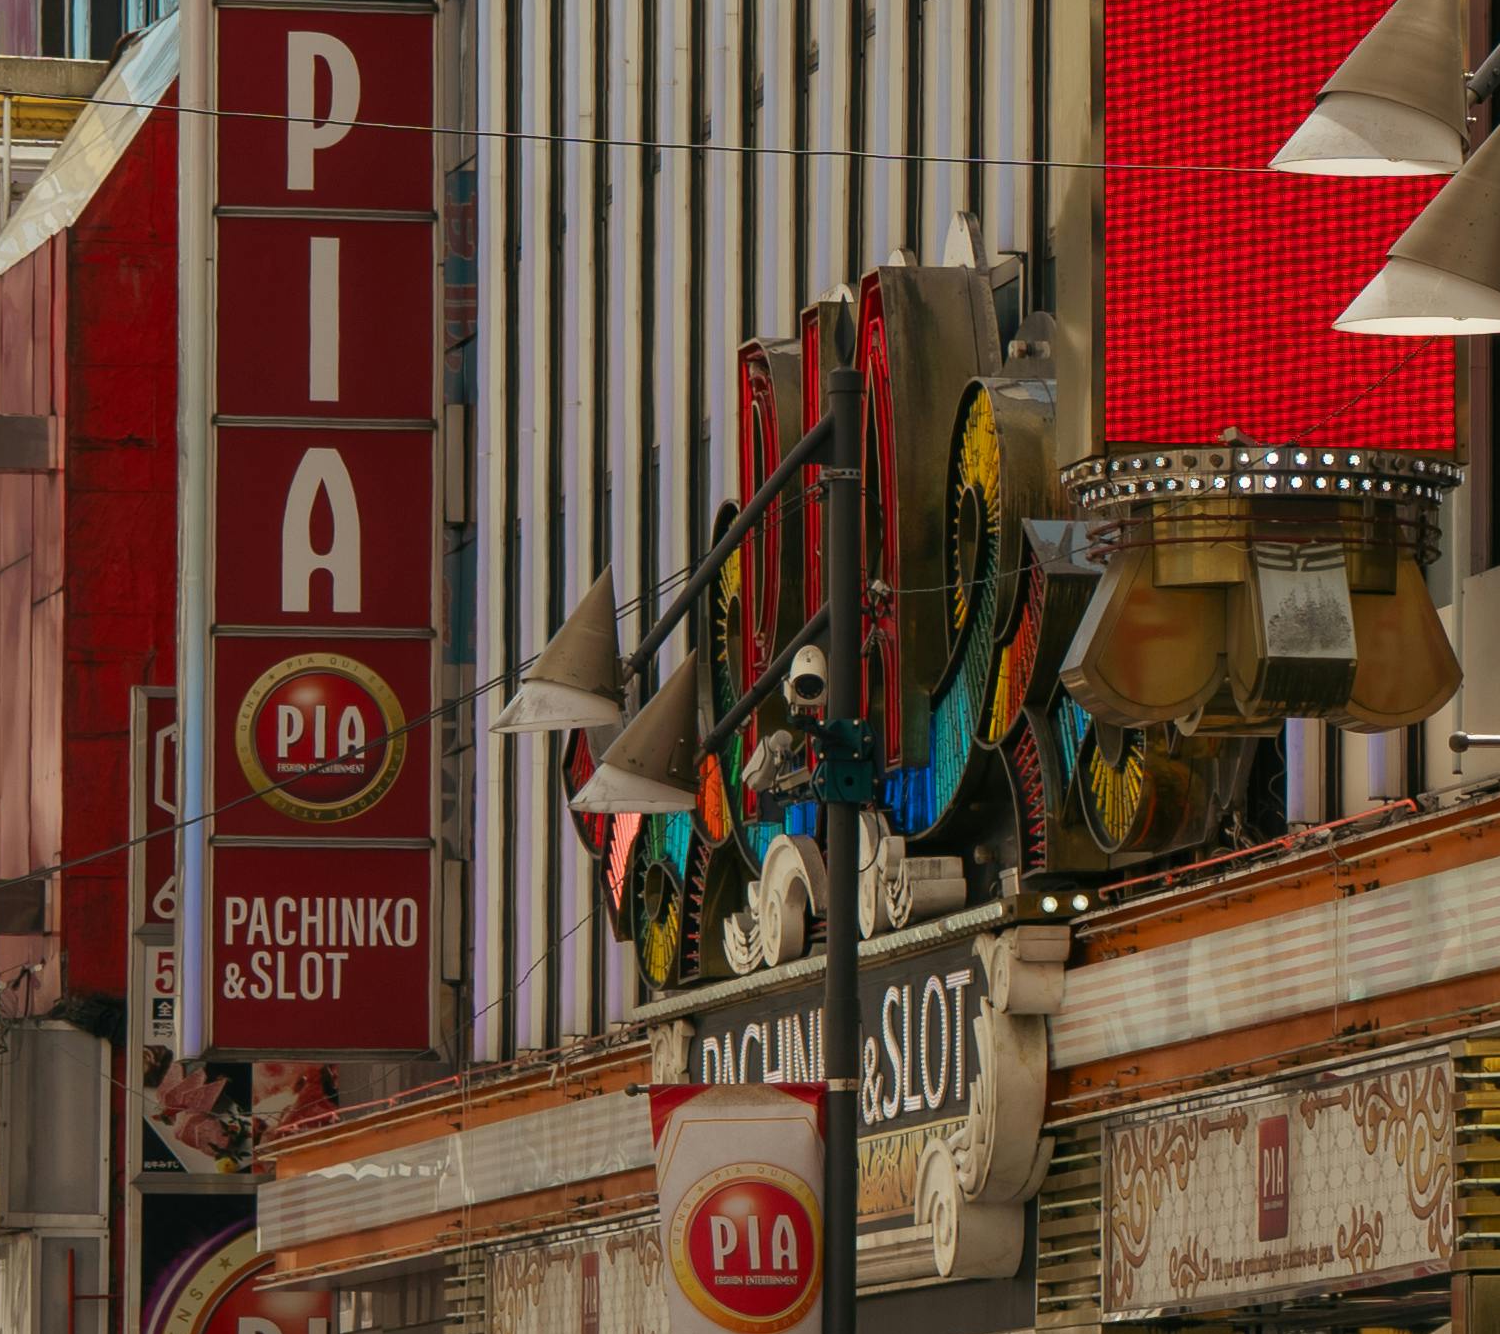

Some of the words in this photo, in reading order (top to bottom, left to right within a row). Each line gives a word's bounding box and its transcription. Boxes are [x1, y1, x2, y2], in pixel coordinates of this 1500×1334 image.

[282, 31, 361, 612] PIA
[277, 704, 366, 758] PIA
[224, 896, 419, 948] PACHINKO
[222, 950, 349, 1001] &SLOT
[1262, 1145, 1286, 1198] PIA
[710, 1214, 799, 1271] PIA
